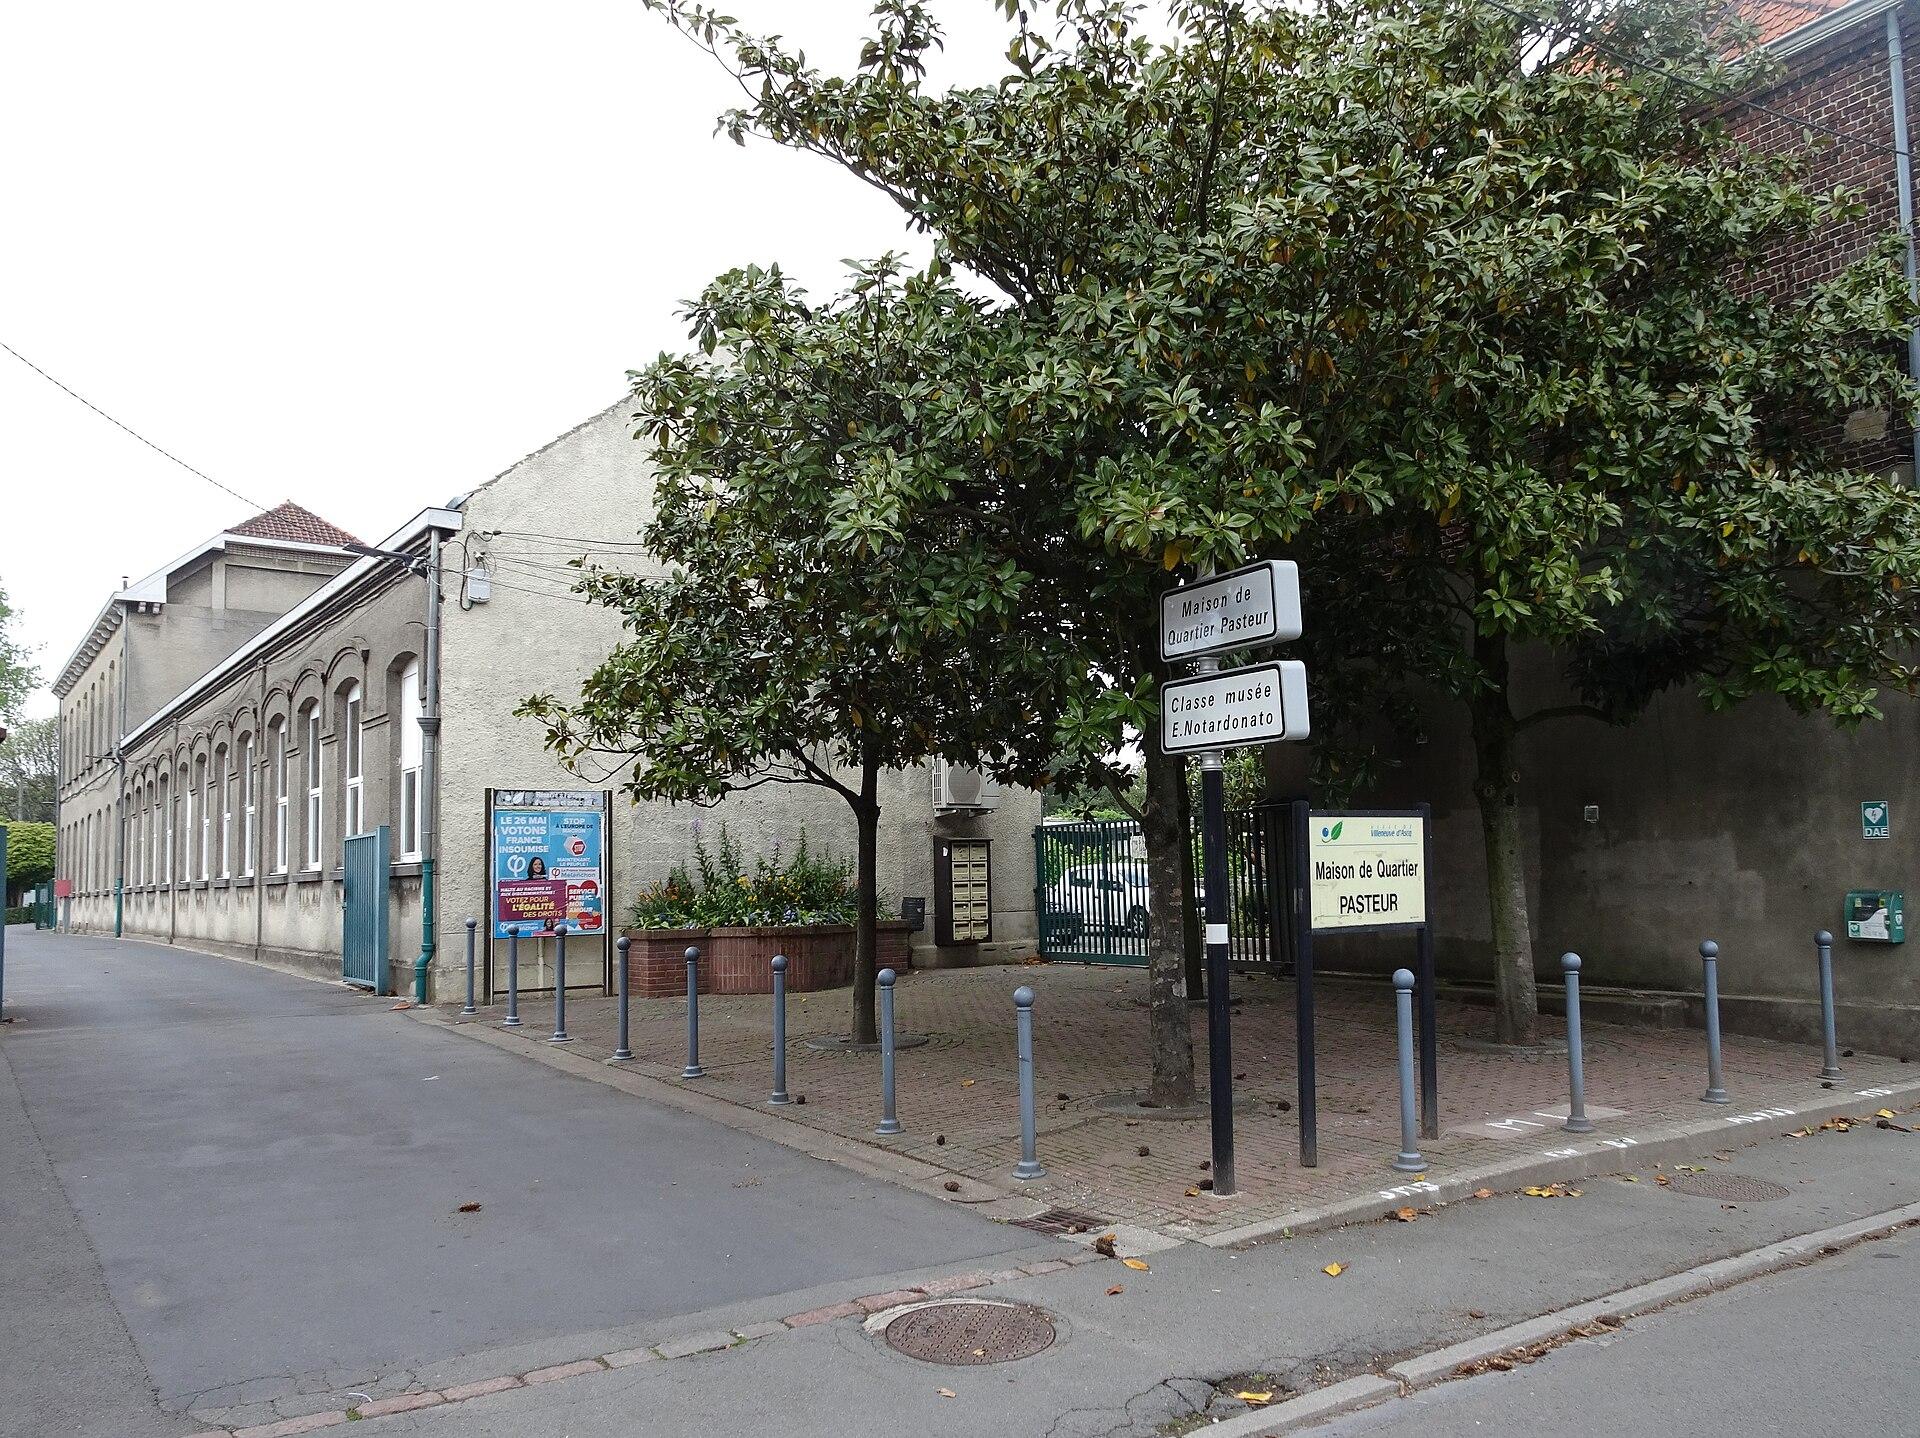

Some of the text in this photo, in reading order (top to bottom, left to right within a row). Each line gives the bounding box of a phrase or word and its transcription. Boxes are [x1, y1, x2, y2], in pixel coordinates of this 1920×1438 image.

[1181, 585, 1252, 618] Maison de
[1168, 610, 1269, 646] Quartier Pasteur
[1171, 682, 1272, 714] Classe musée
[1171, 711, 1274, 738] E.Notardonato
[500, 816, 547, 825] LE 26 MAI
[563, 817, 586, 825] STOP
[501, 826, 547, 835] VOTONS
[1864, 827, 1889, 837] DAE
[506, 836, 542, 844] FRANCE
[499, 845, 549, 854] INSOUMISE
[1315, 859, 1418, 881] Maison de Quartier
[505, 896, 529, 904] VOTEZ
[1340, 893, 1398, 915] PASTEUR
[512, 901, 555, 912] L'ÉGALITÉ
